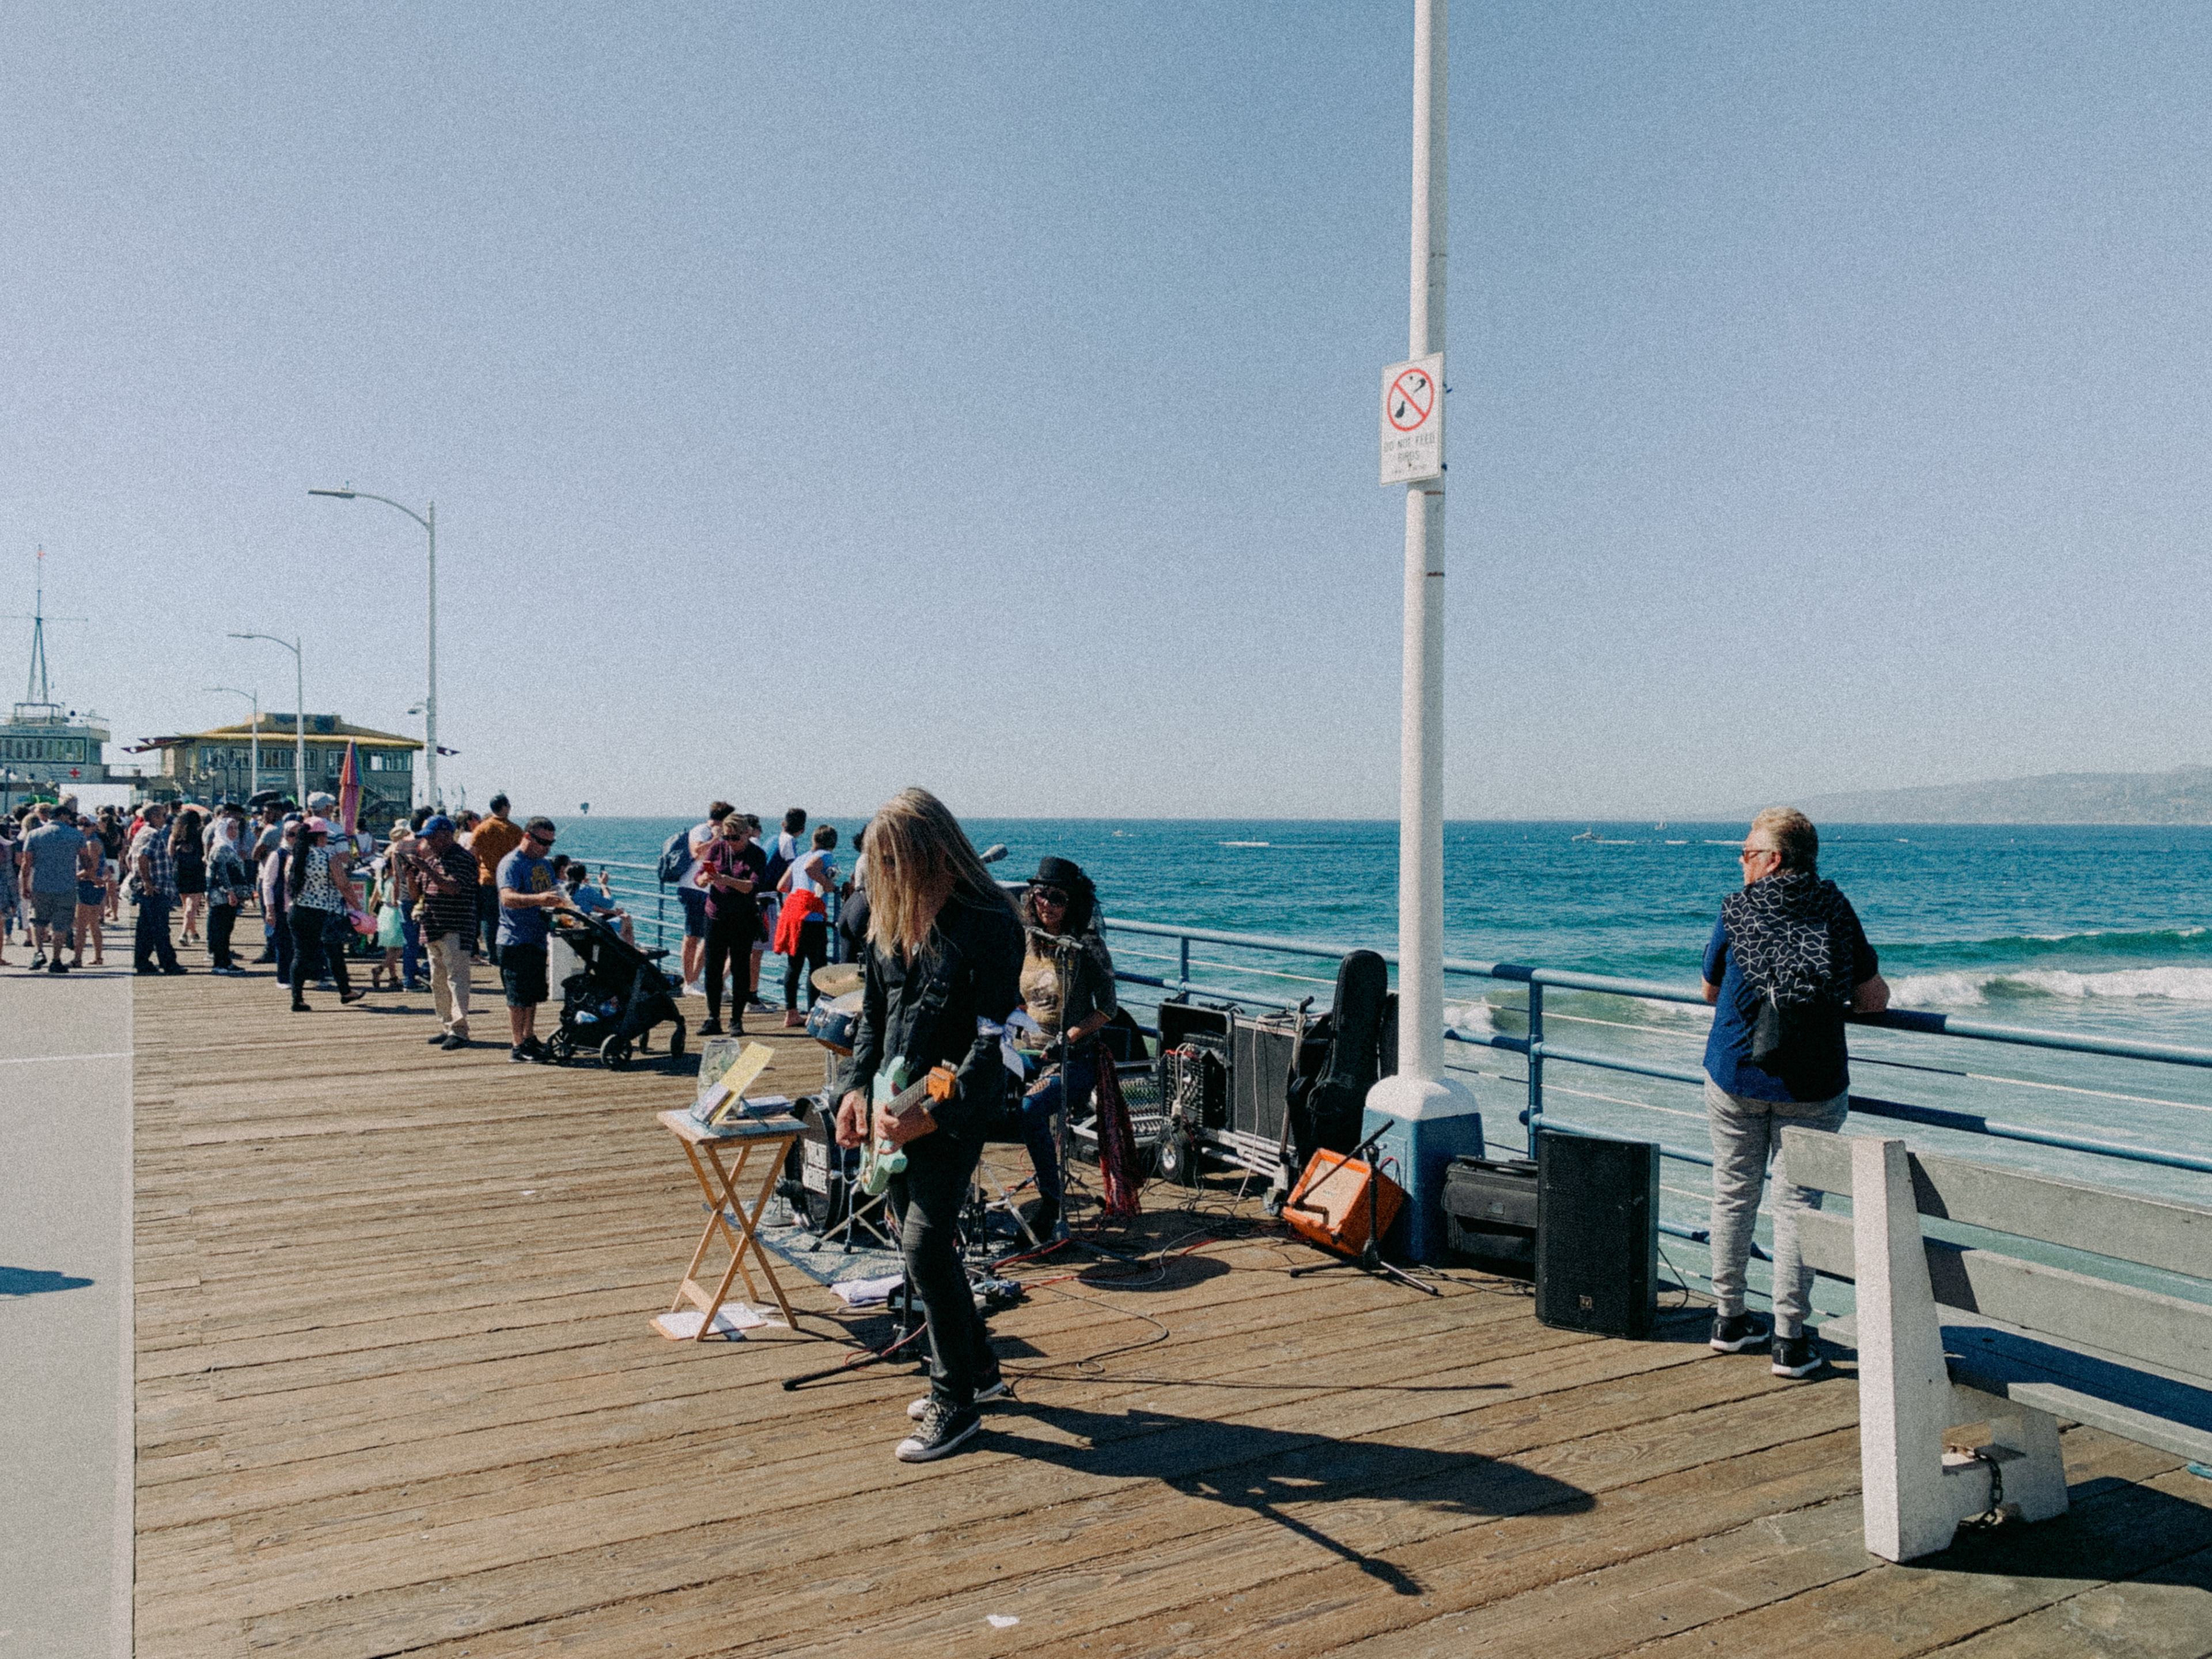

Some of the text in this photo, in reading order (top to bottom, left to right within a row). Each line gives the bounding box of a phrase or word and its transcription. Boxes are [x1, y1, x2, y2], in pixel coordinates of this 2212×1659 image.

[1383, 434, 1435, 452] DO NOT FEED
[1397, 450, 1420, 462] BIRDS
